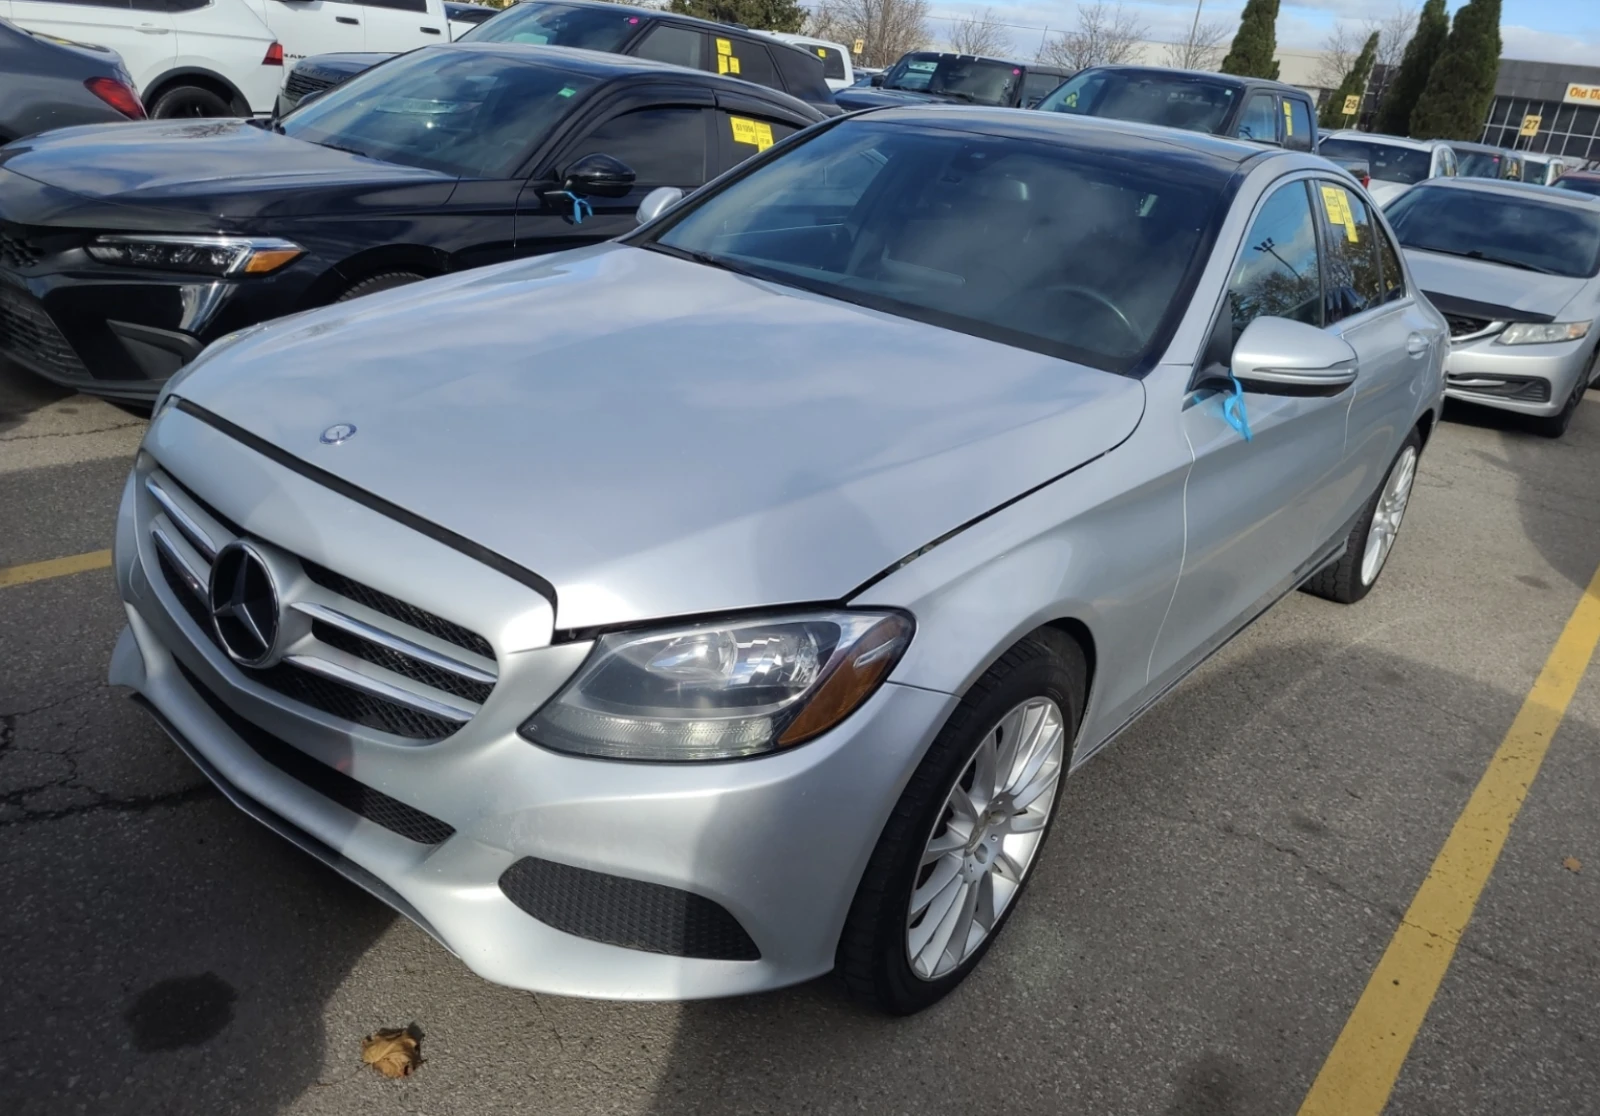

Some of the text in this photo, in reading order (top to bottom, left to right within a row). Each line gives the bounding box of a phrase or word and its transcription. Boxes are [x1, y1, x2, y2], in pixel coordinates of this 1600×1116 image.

[1570, 86, 1588, 98] Old
[1345, 98, 1357, 109] 25
[1523, 119, 1539, 130] 27
